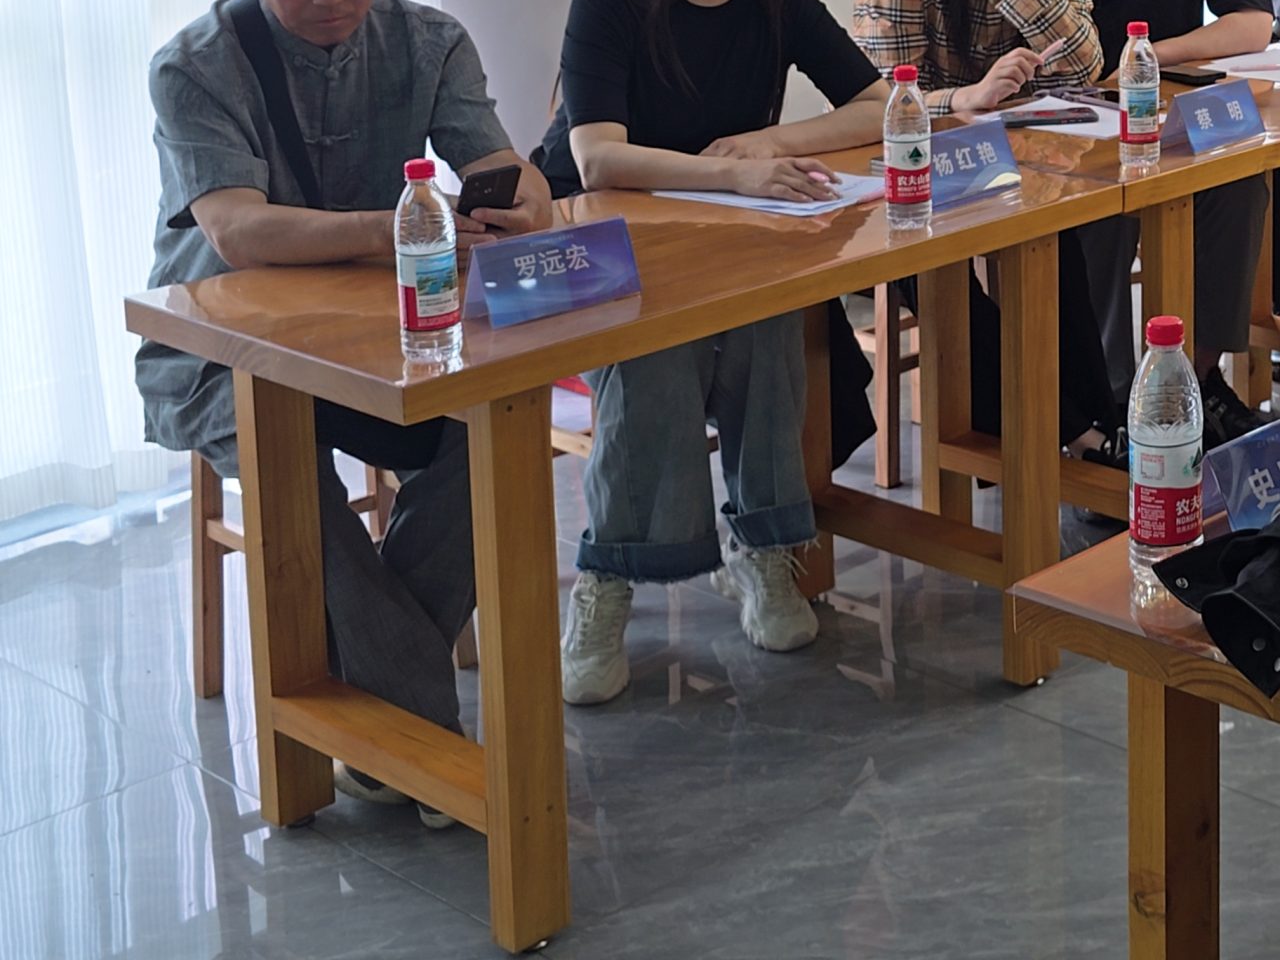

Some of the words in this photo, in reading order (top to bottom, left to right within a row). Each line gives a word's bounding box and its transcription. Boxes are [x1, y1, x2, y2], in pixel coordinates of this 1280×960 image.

[933, 141, 998, 177] 杨红艳
[513, 244, 590, 279] 罗远宏
